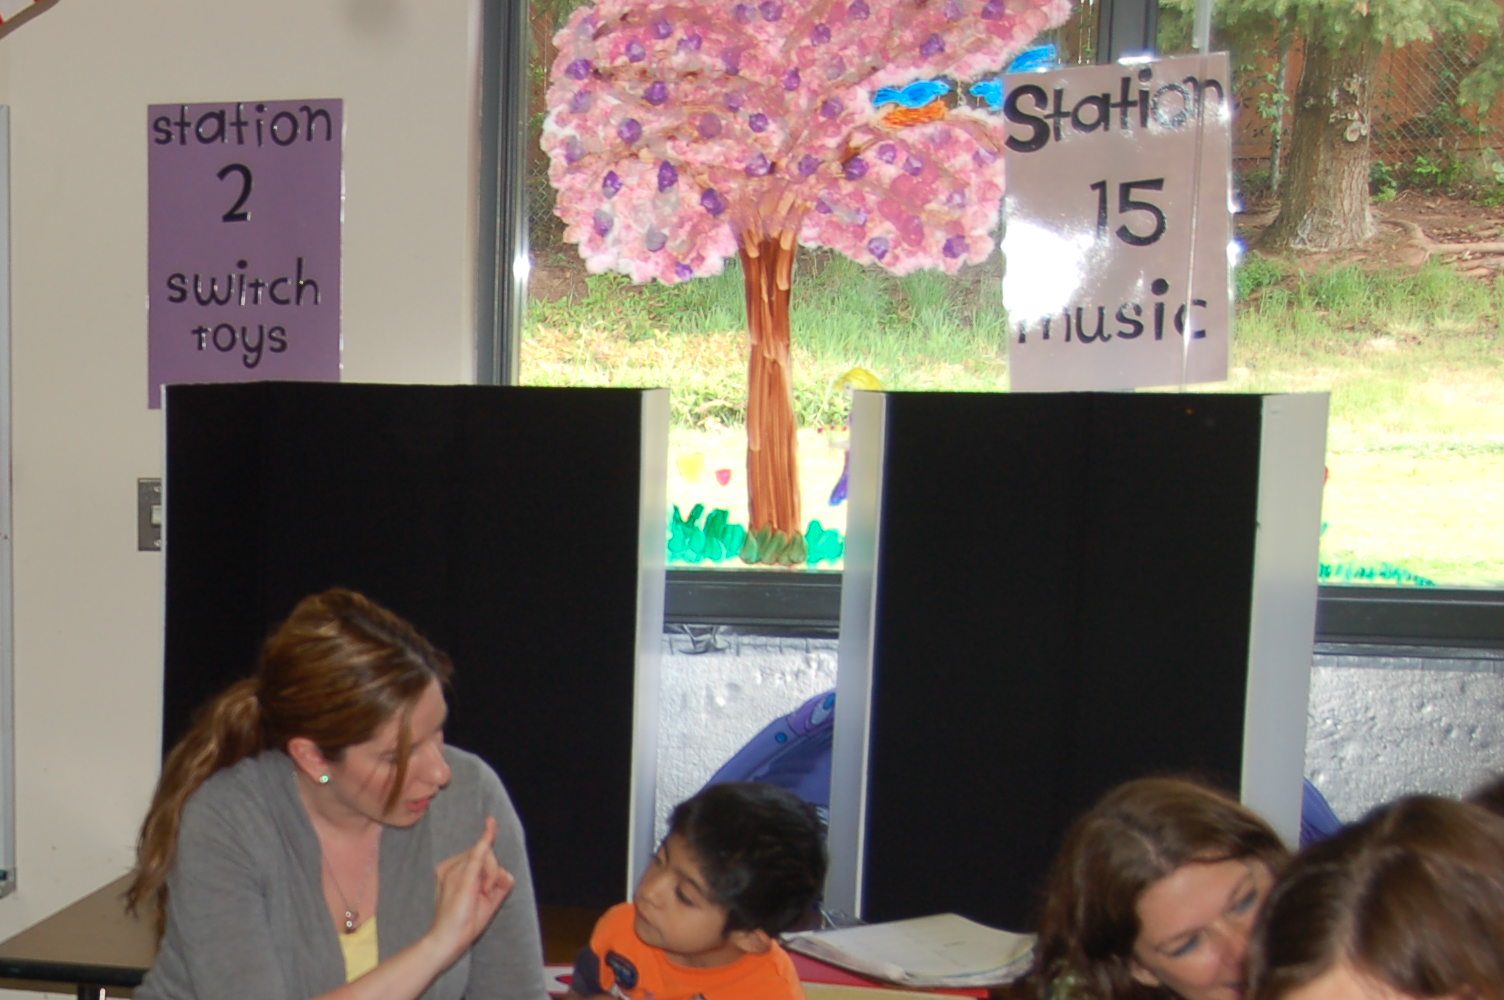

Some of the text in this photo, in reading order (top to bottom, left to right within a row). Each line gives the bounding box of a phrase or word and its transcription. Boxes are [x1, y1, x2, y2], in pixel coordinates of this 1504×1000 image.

[153, 103, 332, 147] station
[1003, 67, 1225, 153] Station
[216, 163, 253, 223] 2
[1089, 177, 1167, 247] 15
[166, 256, 319, 307] switch
[191, 322, 288, 369] toys
